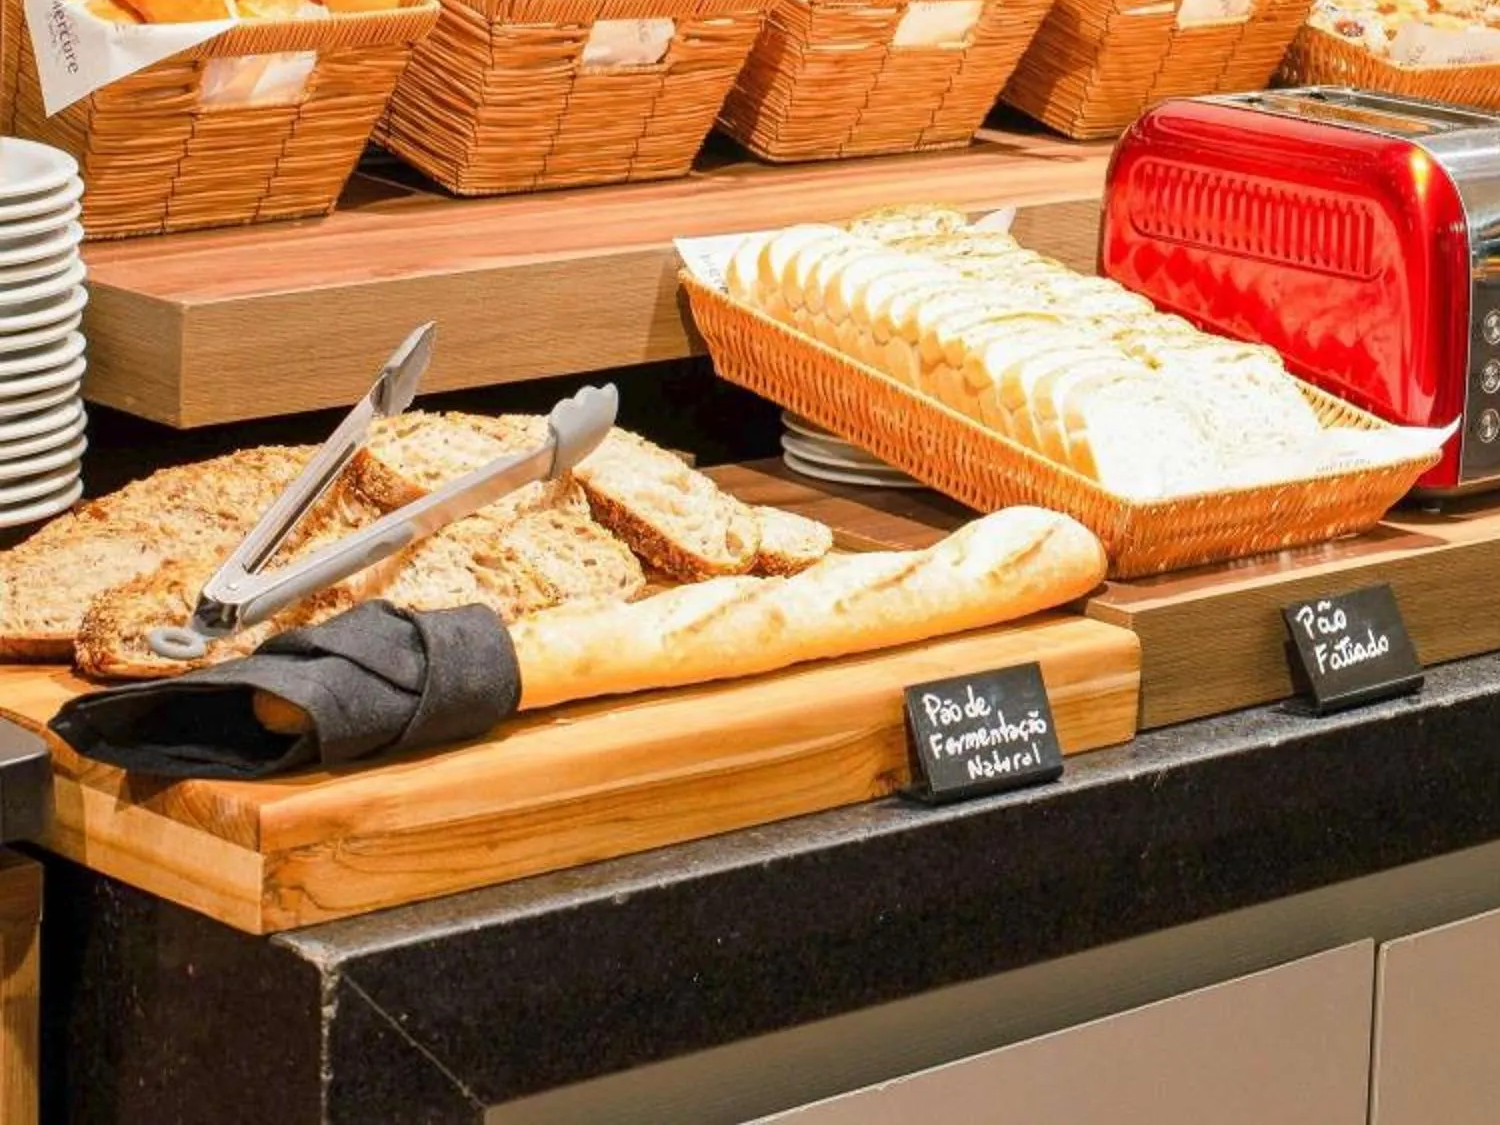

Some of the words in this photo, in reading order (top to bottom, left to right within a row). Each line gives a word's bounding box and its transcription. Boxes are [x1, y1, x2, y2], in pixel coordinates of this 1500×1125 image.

[1296, 600, 1347, 640] Pão
[1314, 627, 1389, 675] Fatiado
[922, 692, 963, 727] Pão
[964, 684, 992, 718] de
[928, 709, 1048, 760] Fermentação
[966, 741, 1041, 780] Natural
